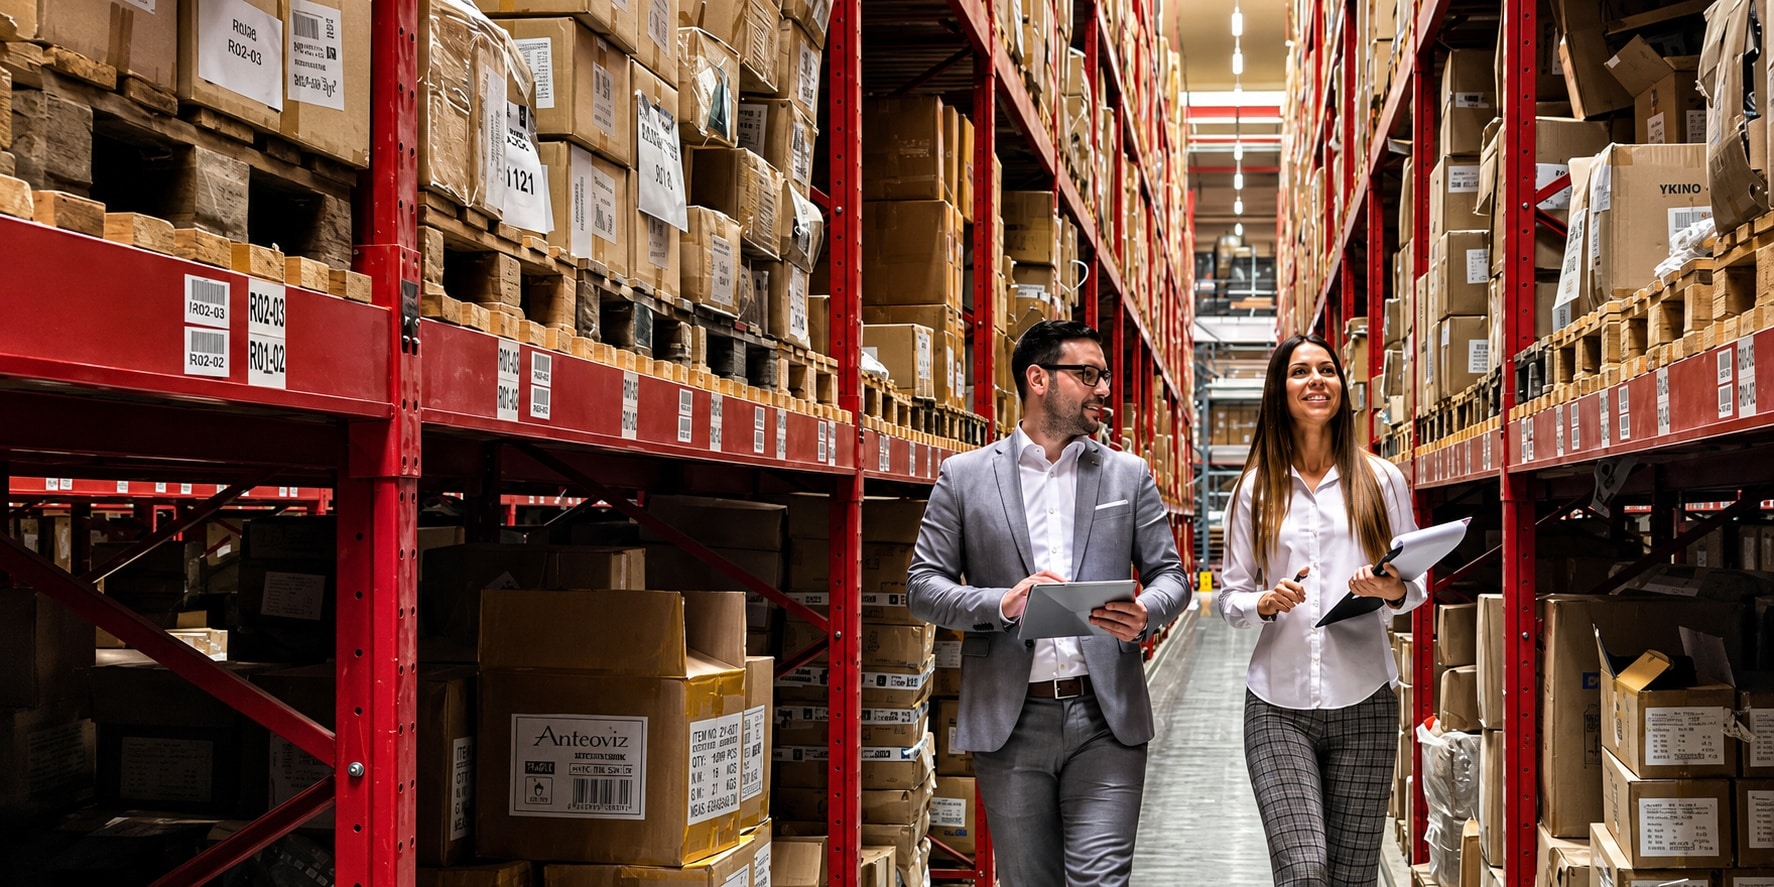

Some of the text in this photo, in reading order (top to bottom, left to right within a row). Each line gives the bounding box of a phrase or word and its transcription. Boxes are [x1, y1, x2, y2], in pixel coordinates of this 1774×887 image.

[228, 39, 262, 66] R02-03
[1659, 183, 1702, 195] YKINO
[249, 292, 285, 327] R02-03
[189, 353, 225, 368] R02-02
[249, 340, 285, 375] R01-02
[532, 725, 629, 748] Anteoviz
